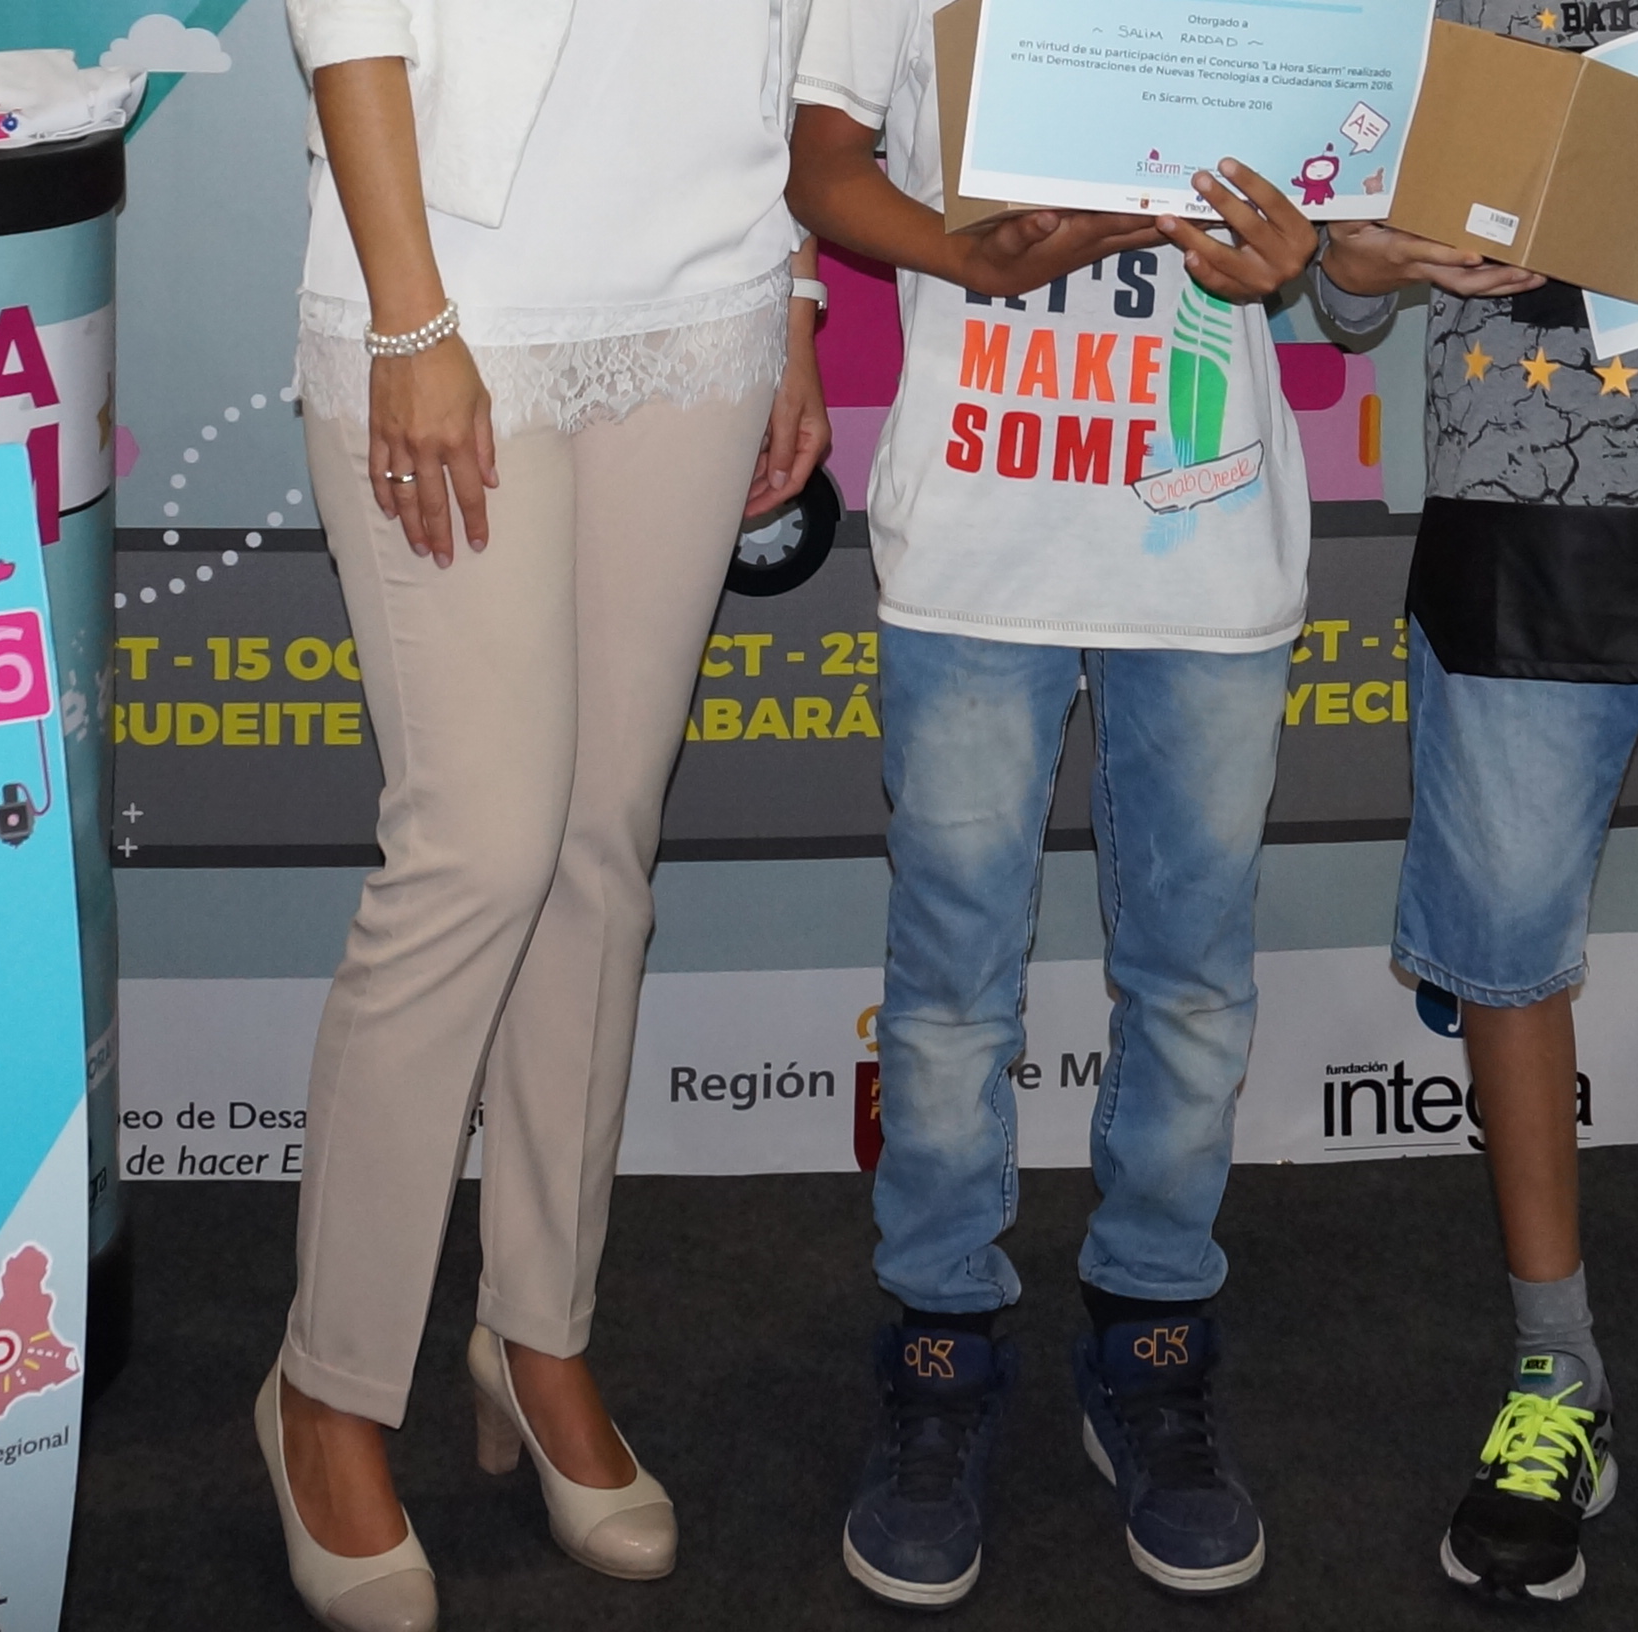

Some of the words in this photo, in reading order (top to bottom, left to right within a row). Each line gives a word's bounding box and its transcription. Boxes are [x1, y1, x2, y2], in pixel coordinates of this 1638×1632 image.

[1187, 14, 1239, 29] Otorgado
[1242, 19, 1249, 29] a
[1011, 51, 1025, 61] en
[1028, 52, 1043, 64] las
[1046, 54, 1137, 73] Demostraciones
[1139, 62, 1153, 74] de
[1156, 65, 1195, 79] Nuevas
[1198, 69, 1260, 85] Tecnologías
[1262, 75, 1268, 84] a
[1271, 75, 1332, 89] Ciudadanos
[1334, 77, 1369, 89] Sicarm
[1019, 40, 1033, 49] en
[1036, 40, 1069, 54] virtud
[1072, 43, 1087, 55] de
[1089, 47, 1102, 56] su
[1104, 47, 1178, 63] participación
[1180, 55, 1194, 65] en
[1197, 56, 1207, 66] el
[1209, 56, 1259, 70] Concurso
[1280, 63, 1304, 74] Hora
[1347, 66, 1392, 78] realizado
[1141, 91, 1156, 102] En
[1201, 96, 1246, 109] Octubre
[1248, 99, 1273, 111] 2016
[1136, 158, 1181, 175] sicarm
[959, 319, 1163, 405] MAKE
[206, 636, 272, 681] 15
[1324, 1061, 1389, 1076] fundación
[670, 1061, 836, 1111] Región
[176, 1102, 216, 1130] de
[125, 1144, 165, 1176] de
[177, 1143, 270, 1176] hacer
